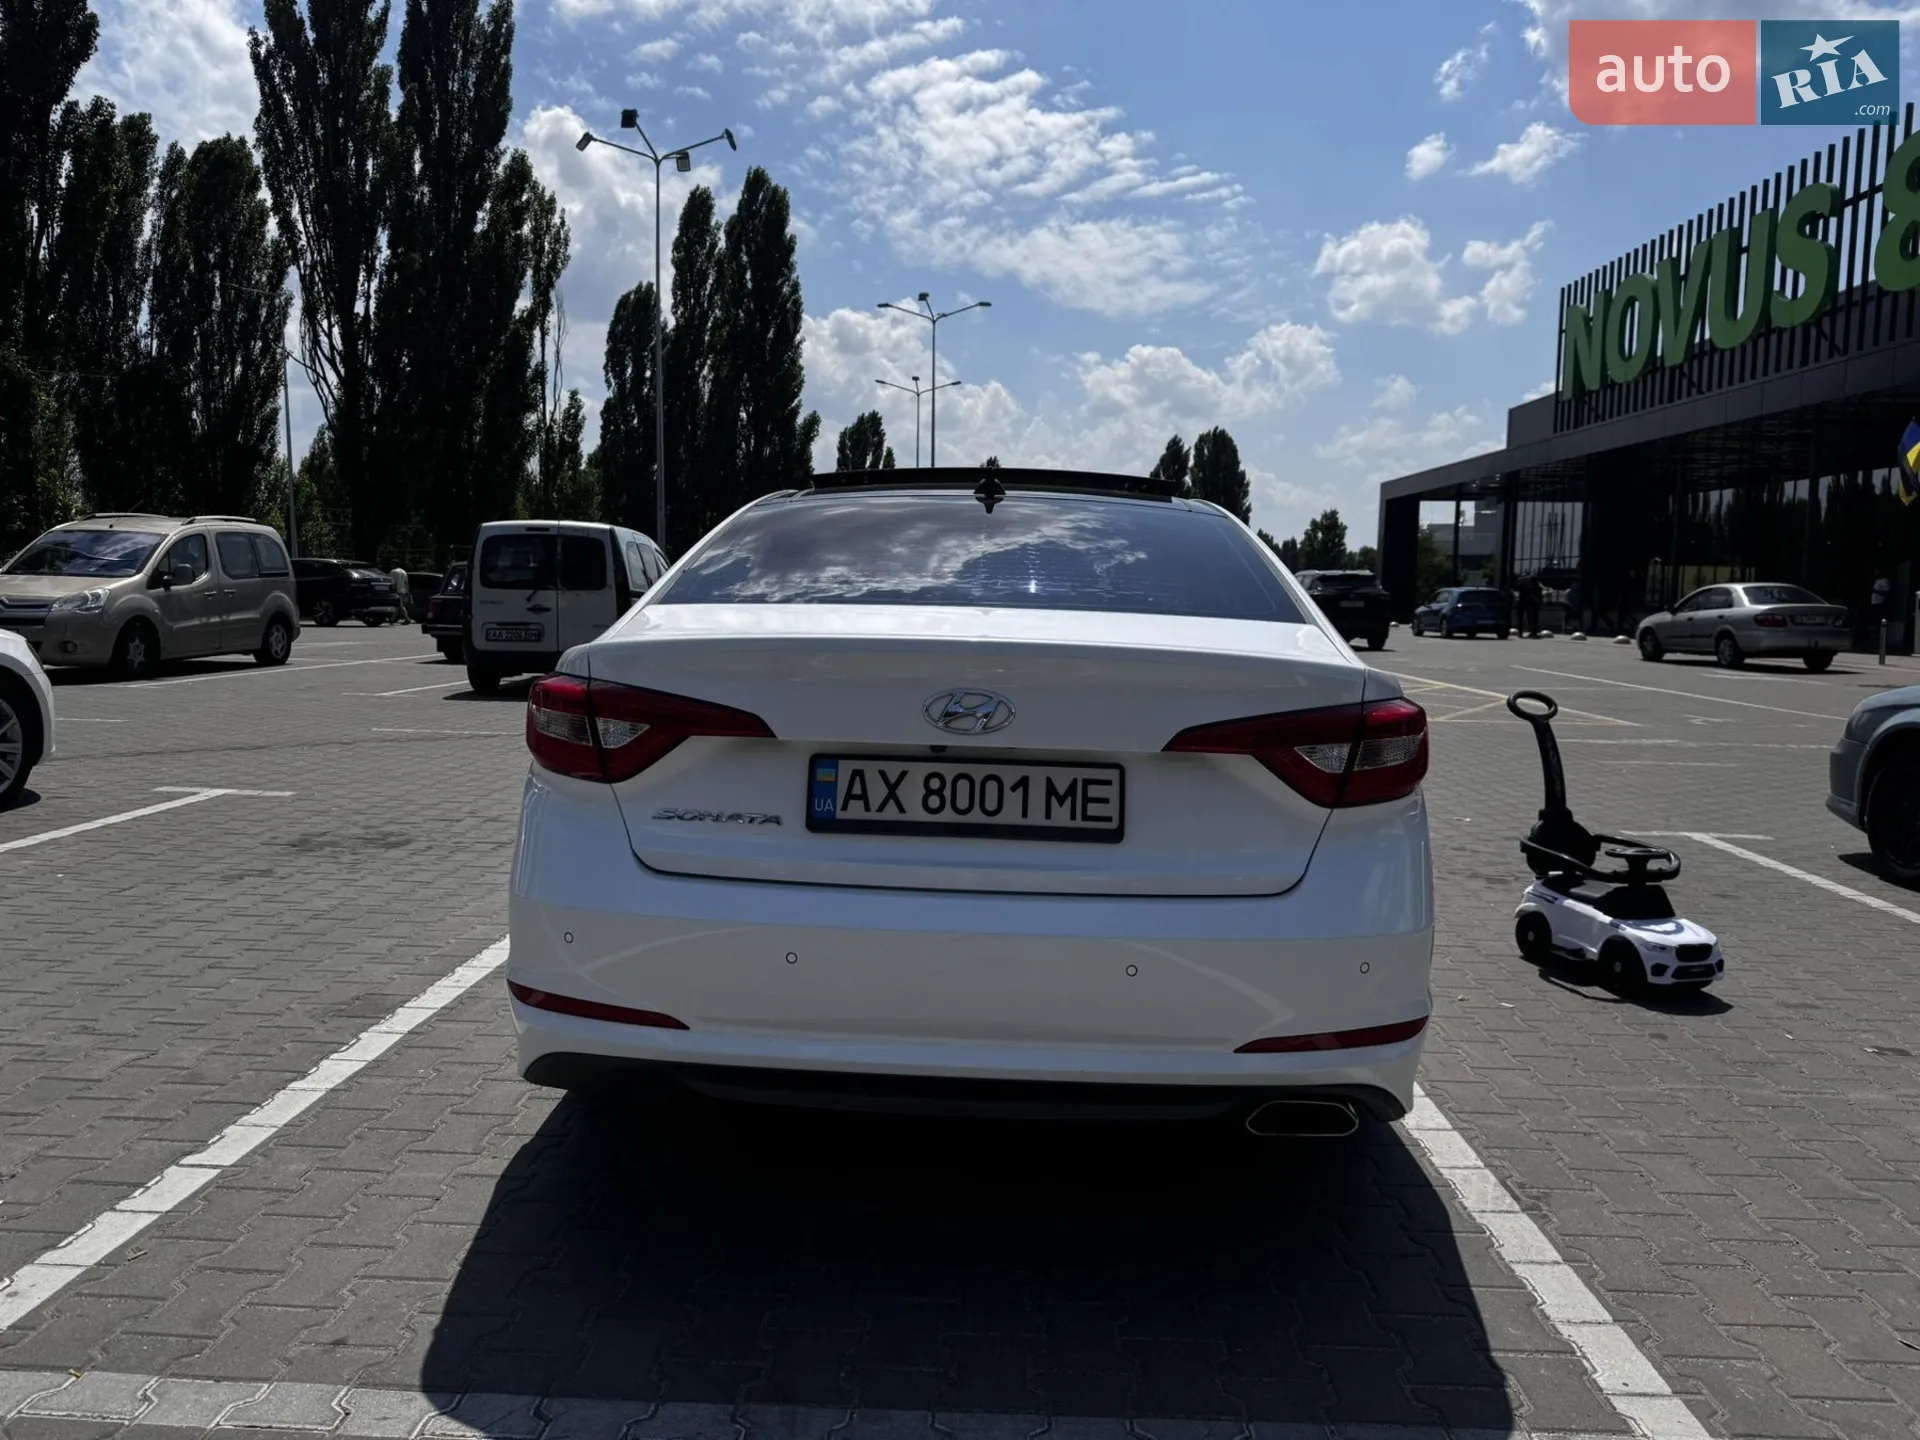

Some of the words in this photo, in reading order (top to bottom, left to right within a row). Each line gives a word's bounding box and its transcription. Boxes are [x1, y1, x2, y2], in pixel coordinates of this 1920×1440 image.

[1563, 182, 1841, 400] NOVUS
[814, 797, 835, 812] UA
[840, 768, 910, 814] AX
[921, 771, 1031, 819] 8001
[1044, 775, 1114, 823] ME
[651, 807, 783, 826] SONATA
